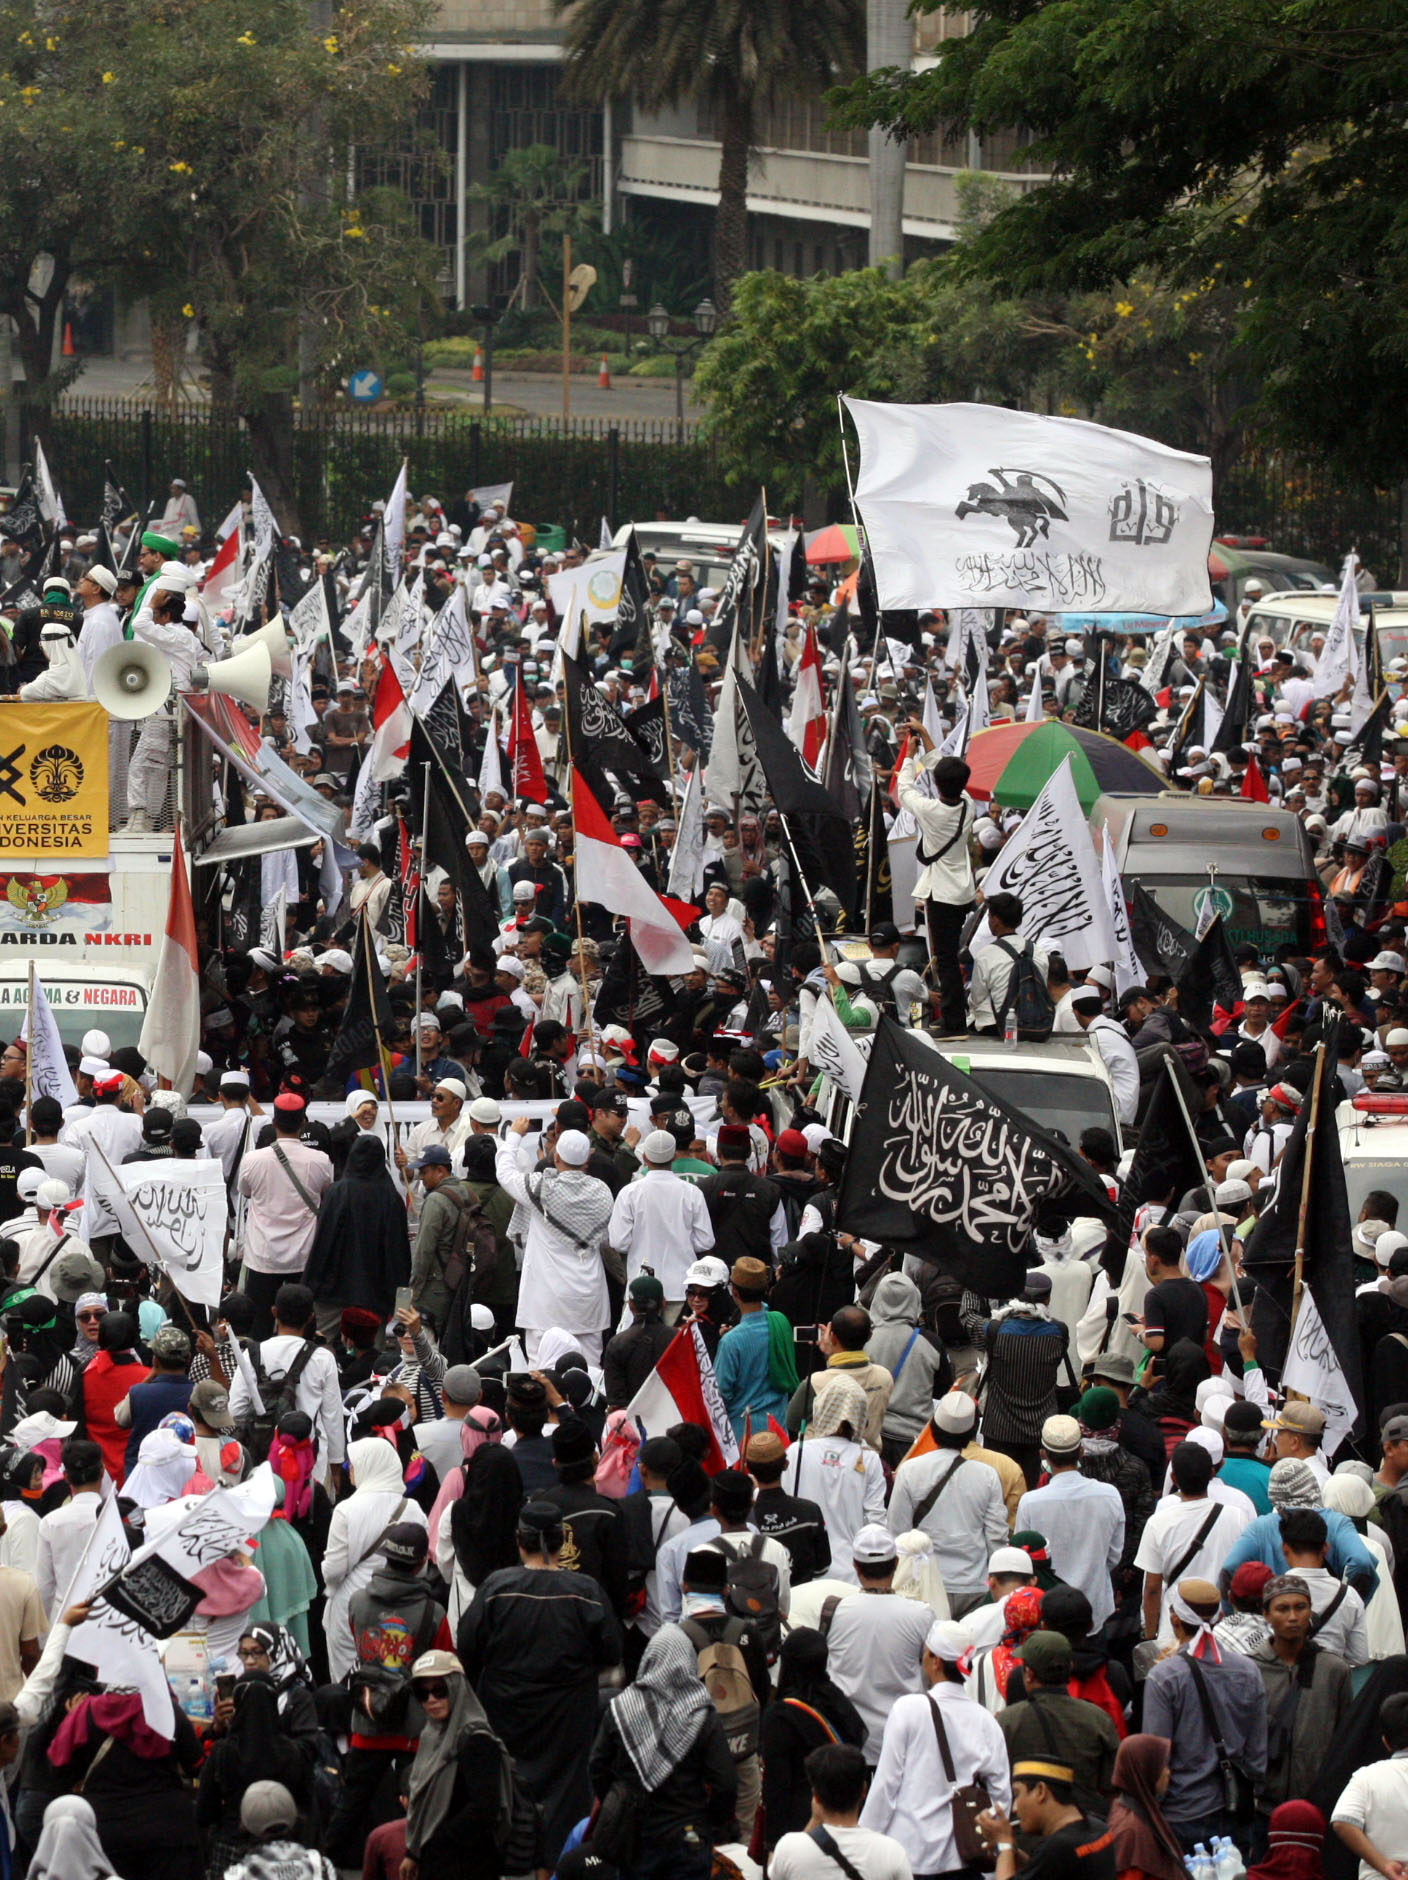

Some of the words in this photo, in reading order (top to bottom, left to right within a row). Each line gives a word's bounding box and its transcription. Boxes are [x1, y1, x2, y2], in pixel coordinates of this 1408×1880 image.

[6, 814, 57, 822] KELUARGA
[60, 814, 92, 822] BESAR
[85, 933, 152, 946] NKRI
[65, 990, 80, 1004] &
[83, 988, 137, 1006] NEGARA
